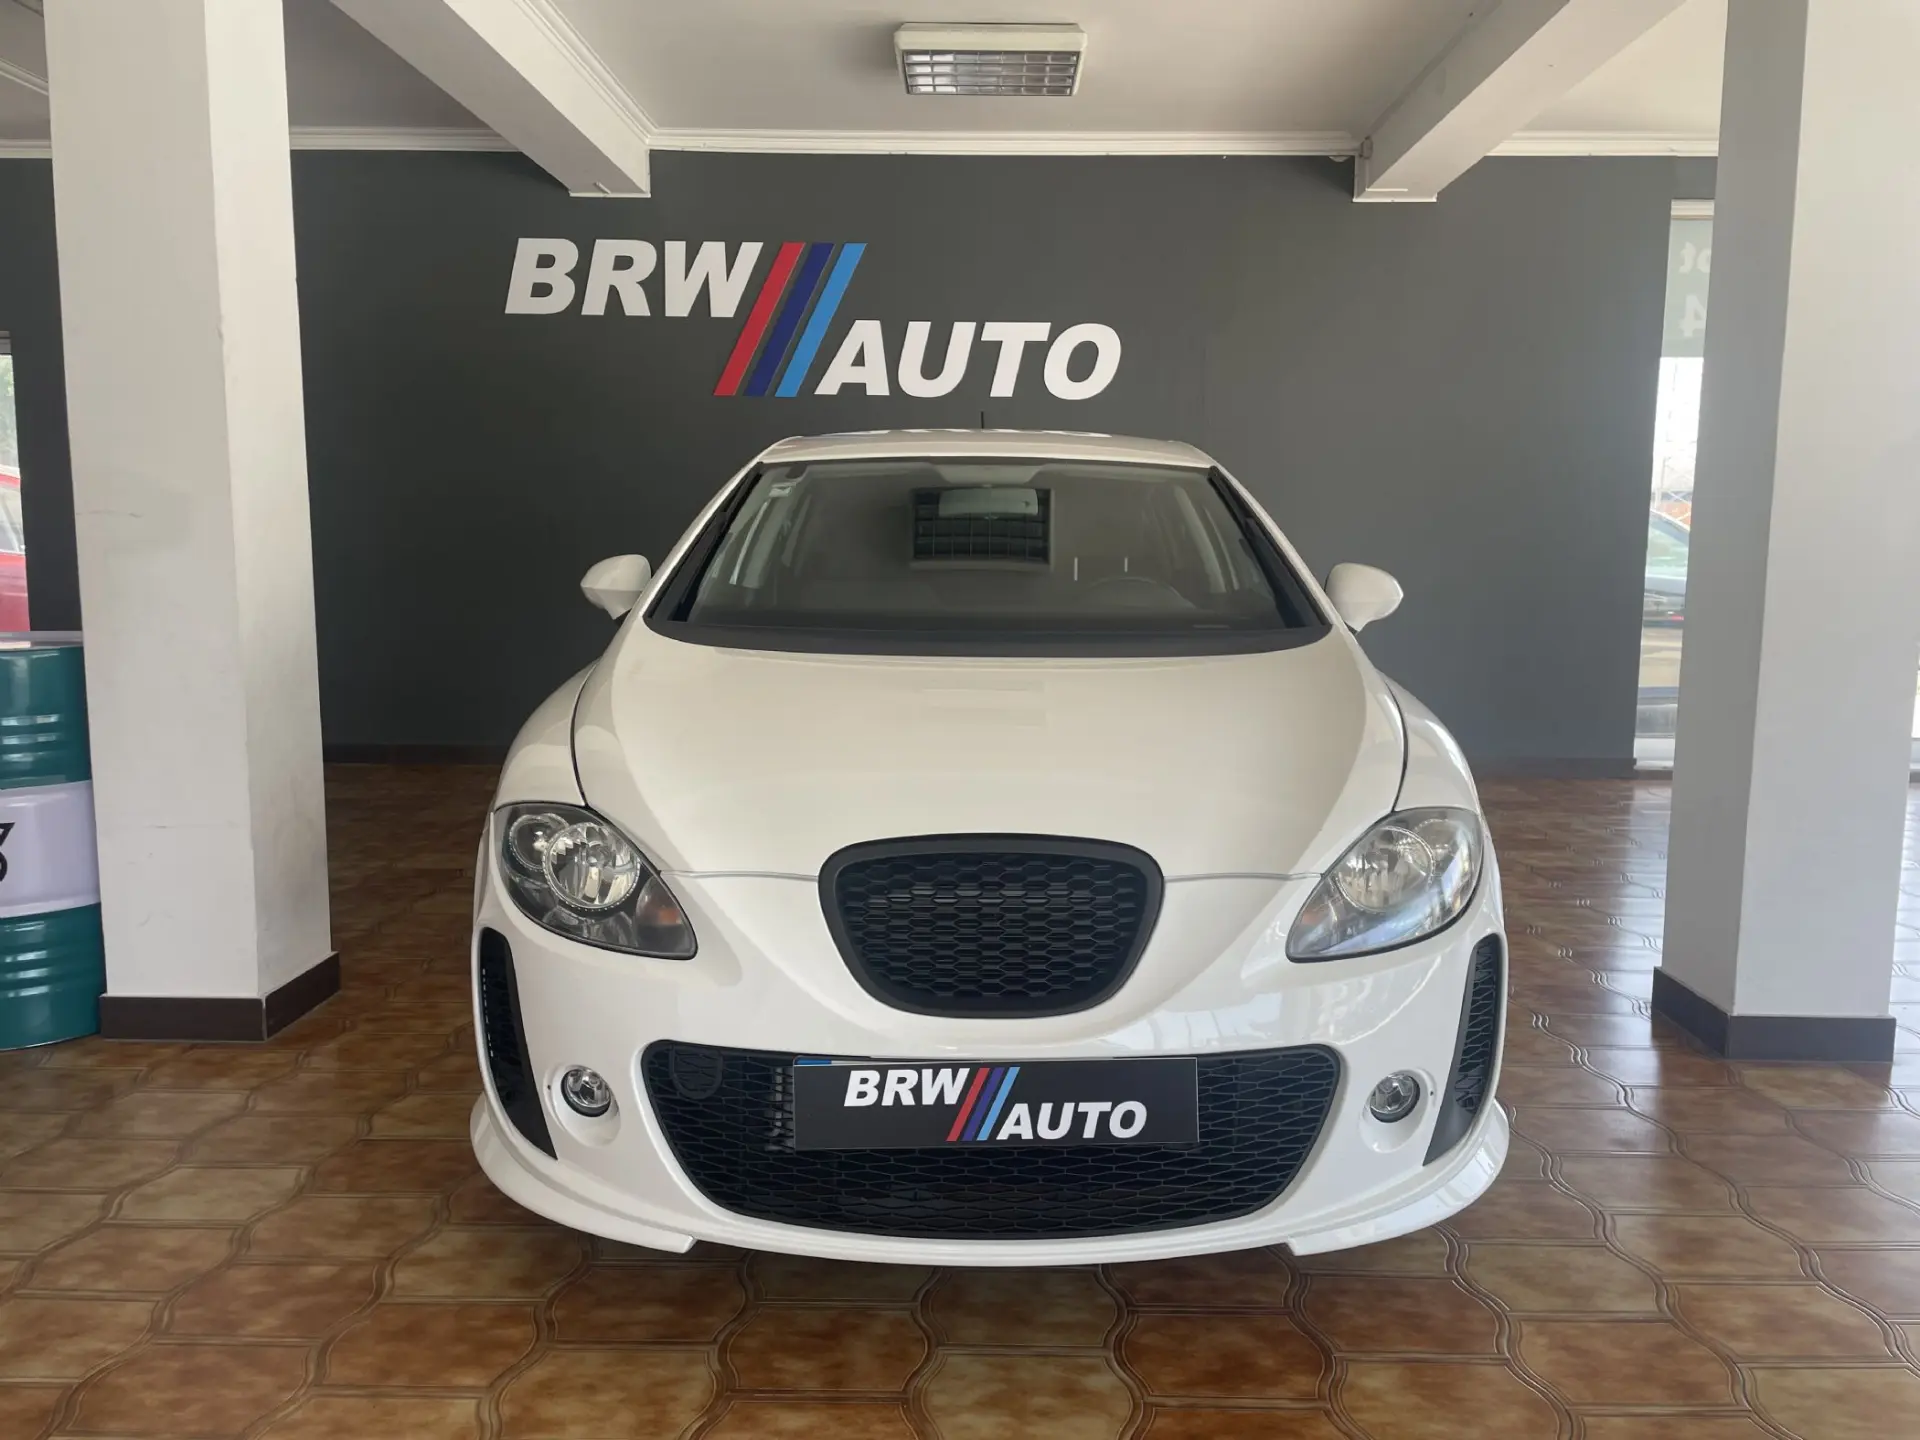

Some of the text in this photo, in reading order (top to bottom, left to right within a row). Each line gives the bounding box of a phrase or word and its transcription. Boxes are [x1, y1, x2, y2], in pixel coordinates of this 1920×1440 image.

[504, 237, 763, 318] BRW
[813, 319, 1122, 400] AUTO
[843, 1067, 970, 1107] BRW
[995, 1100, 1147, 1140] AUTO
